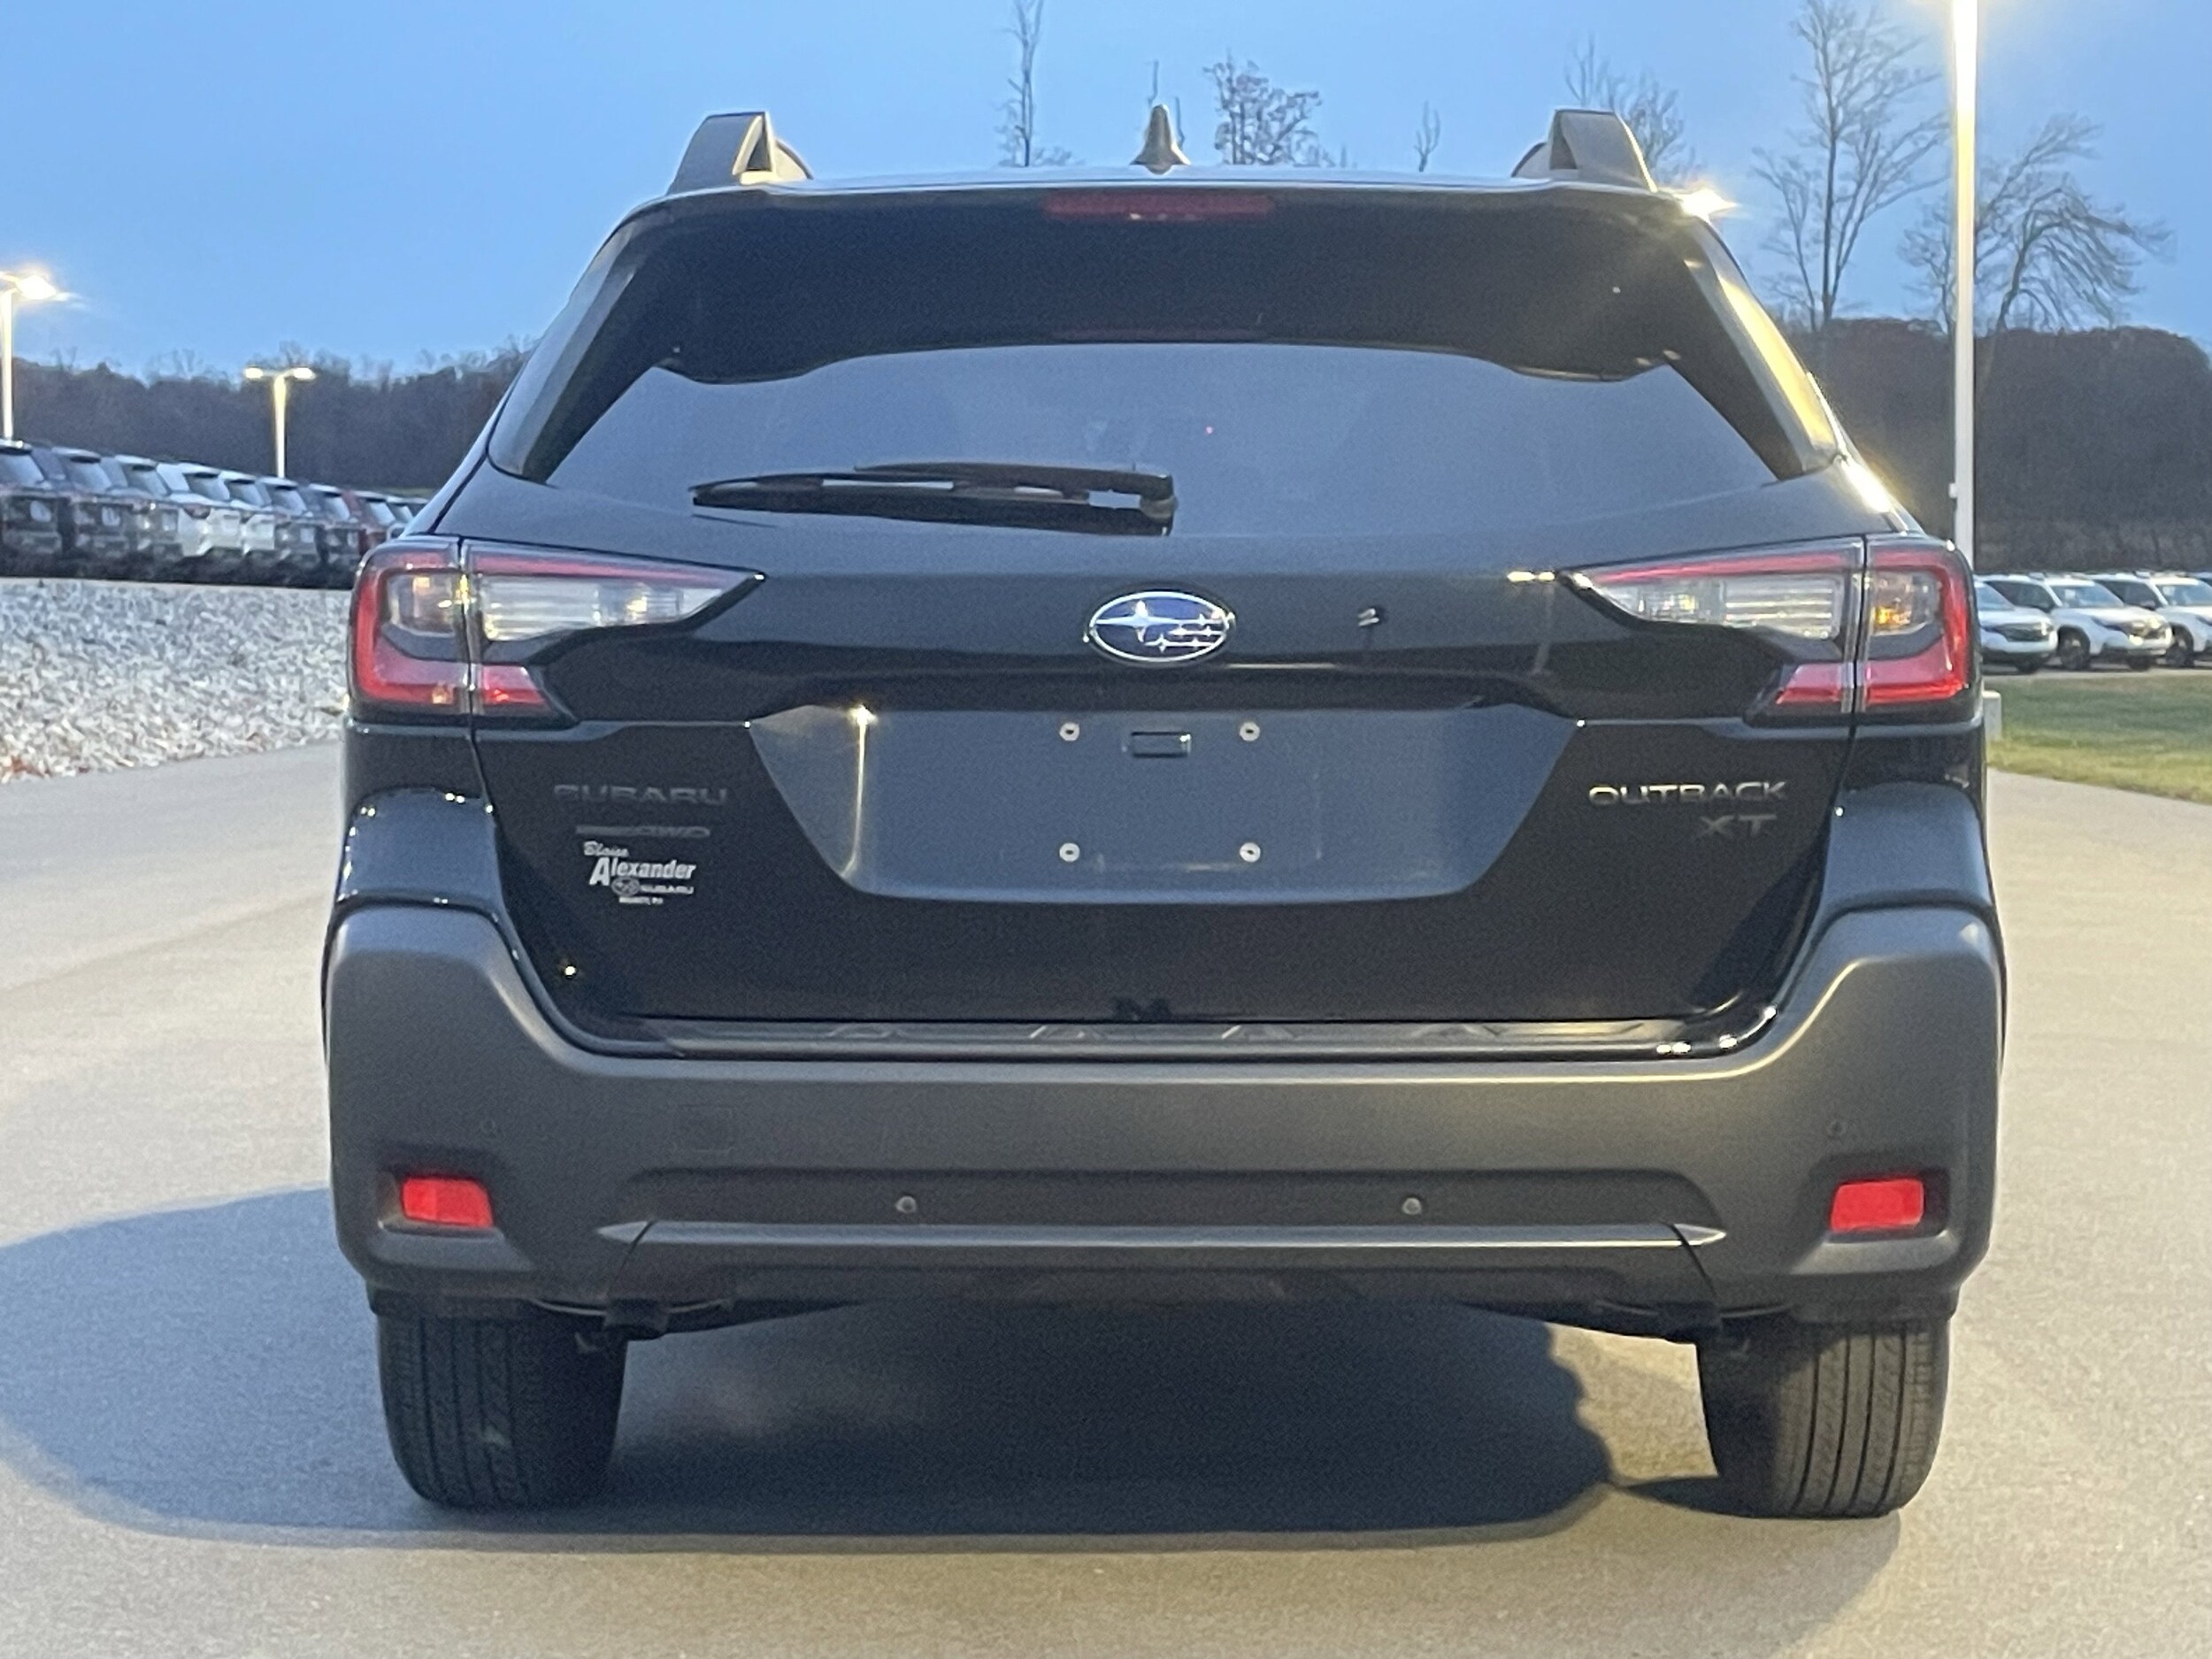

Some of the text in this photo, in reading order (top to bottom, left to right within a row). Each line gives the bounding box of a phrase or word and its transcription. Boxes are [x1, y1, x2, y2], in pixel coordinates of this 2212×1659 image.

[1588, 780, 1786, 806] OUTBACK
[1699, 812, 1778, 838] XT
[588, 856, 697, 887] Alexander
